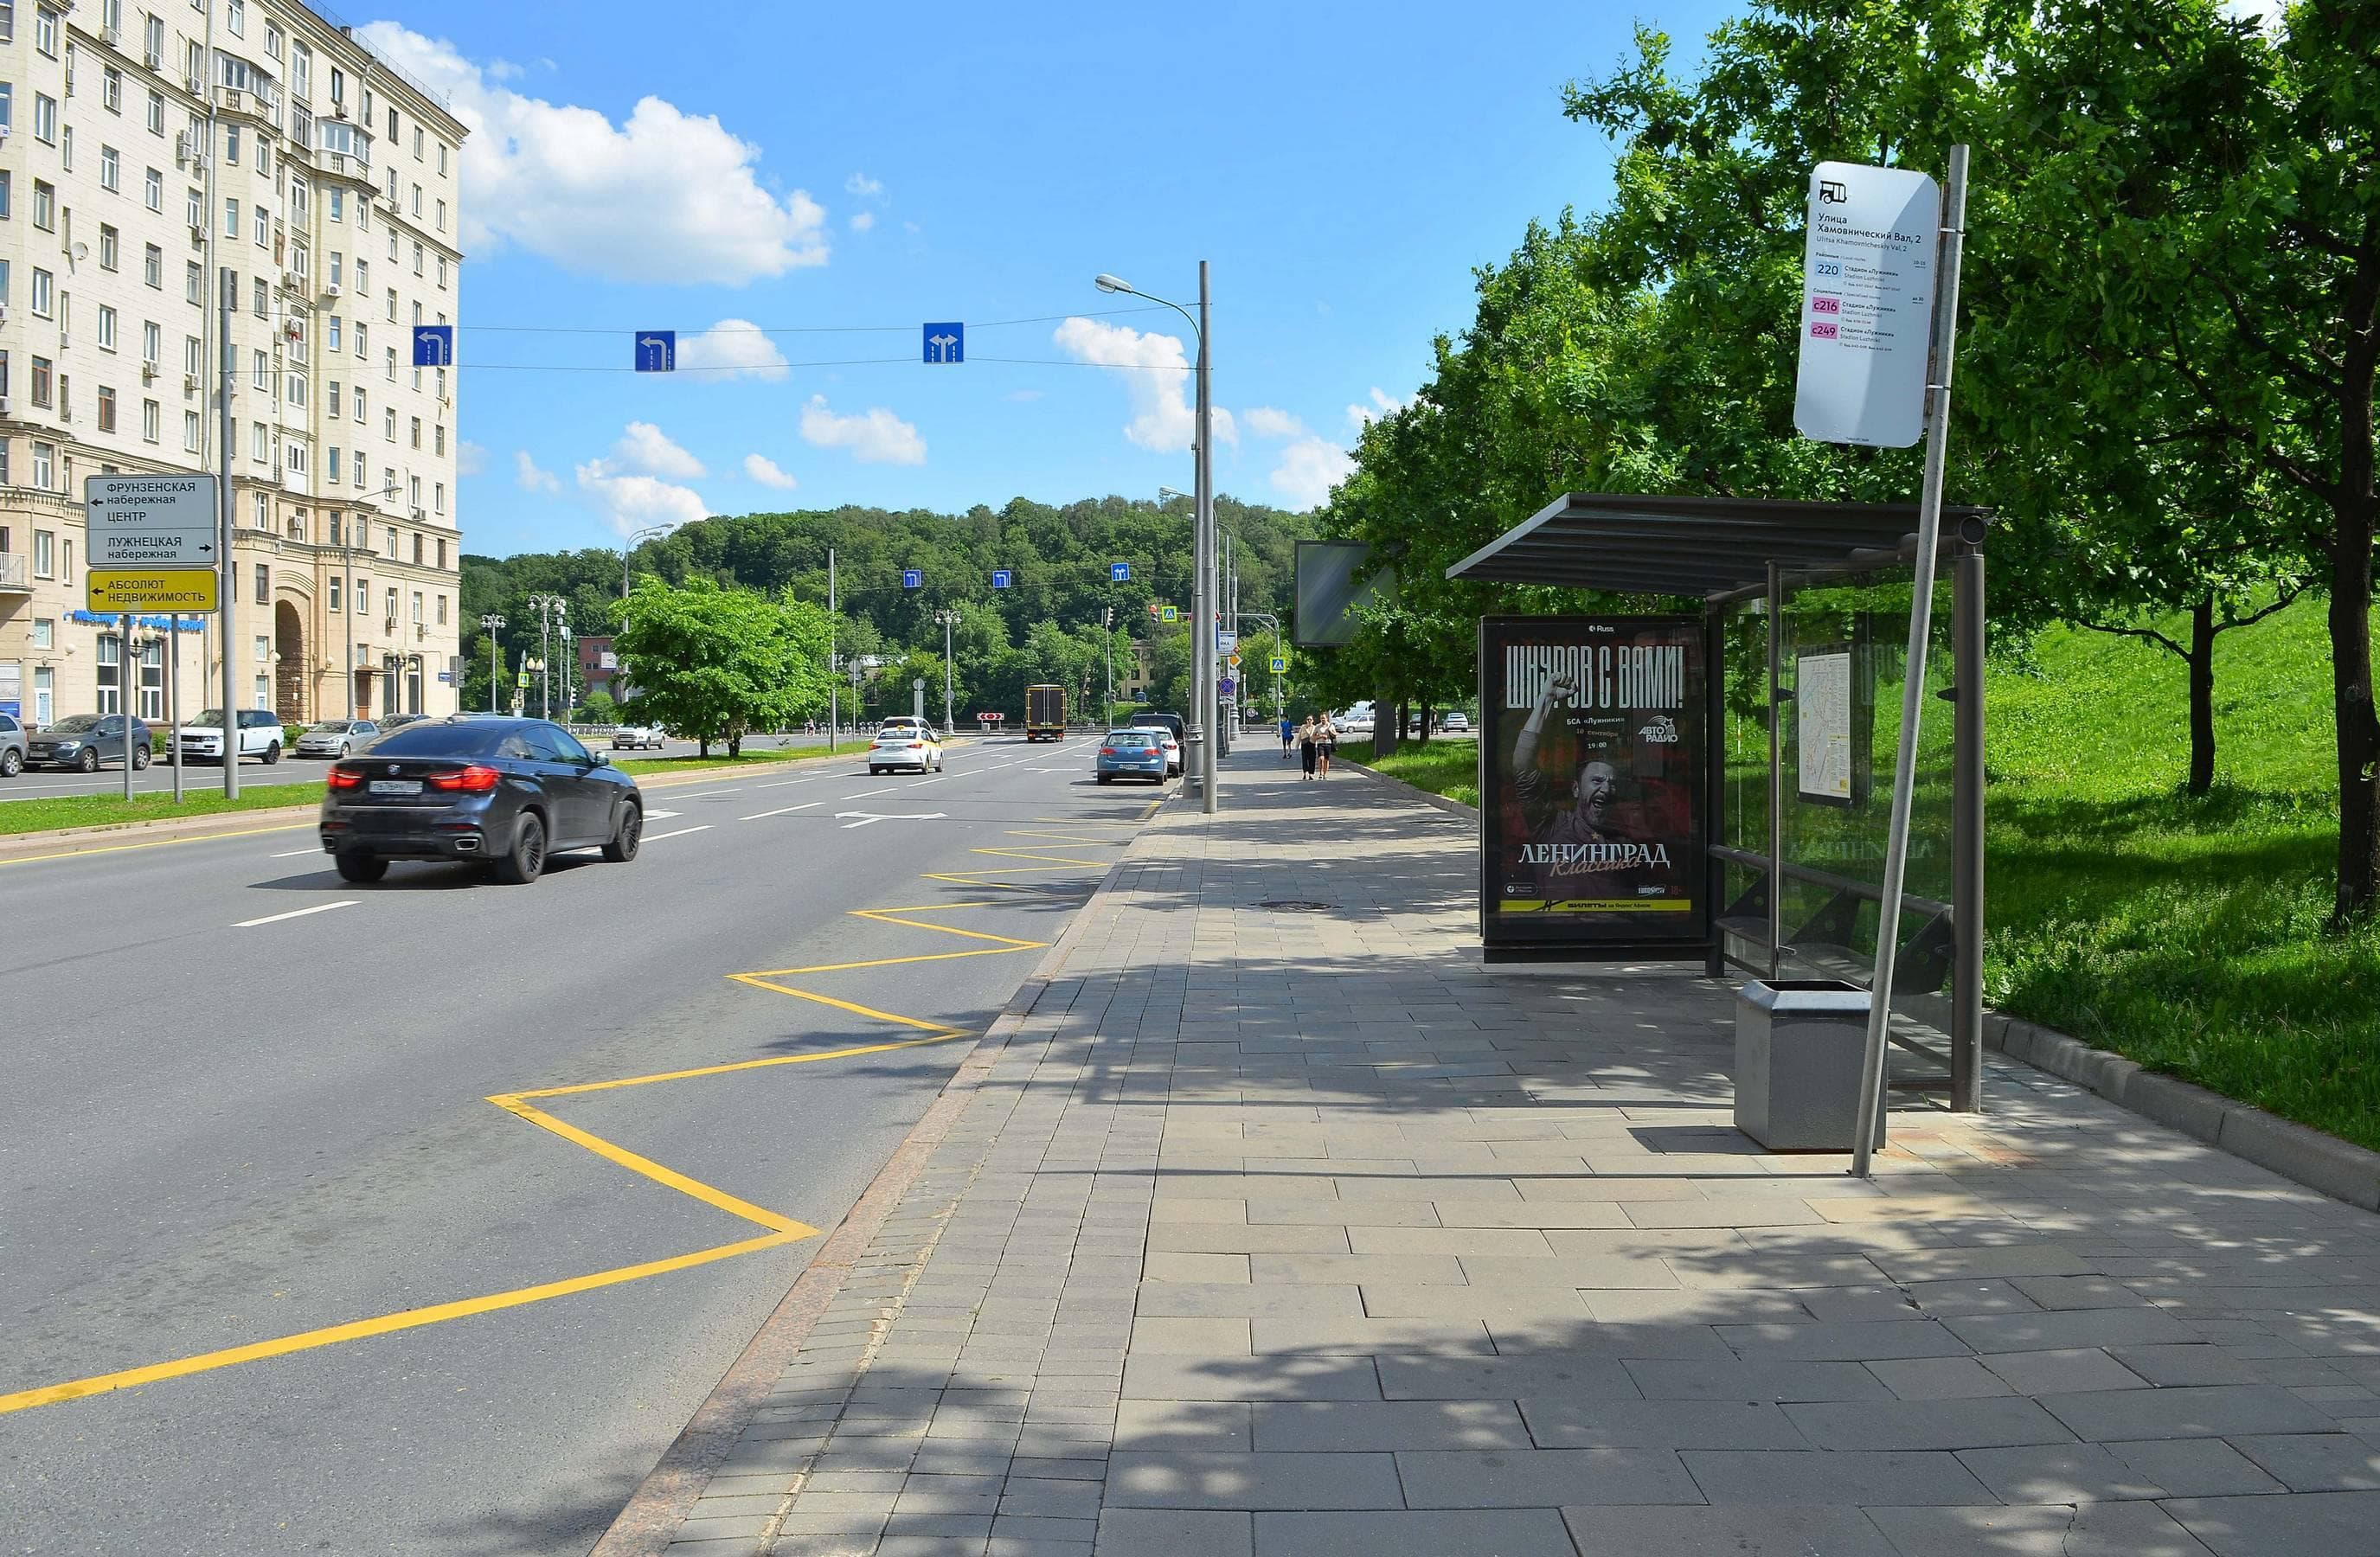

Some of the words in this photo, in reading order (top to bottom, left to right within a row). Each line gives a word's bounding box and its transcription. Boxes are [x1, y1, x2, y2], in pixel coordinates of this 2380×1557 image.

[1819, 213, 1847, 224] Улица
[1818, 224, 1892, 240] Хамовнический
[1894, 233, 1914, 244] Вал,
[1818, 264, 1838, 275] 220
[1814, 300, 1838, 311] с216
[1812, 326, 1836, 336] с249
[107, 483, 196, 492] ФРУНЗЕНСКАЯ
[107, 495, 176, 506] набережная
[107, 512, 146, 522] ЦЕНТР
[107, 537, 182, 548] ЛУЖНЕЦКАЯ
[108, 549, 176, 561] набережная
[107, 580, 165, 589] АБСОЛЮТ
[108, 592, 206, 604] НЕДВИЖИМОСТЬ
[1599, 645, 1611, 708] С
[1618, 645, 1683, 708] ВАМИ!
[1583, 717, 1625, 726] «Лужники»
[1638, 726, 1665, 735] АВТО
[1518, 843, 1671, 869] ЛЕНИНГРАД
